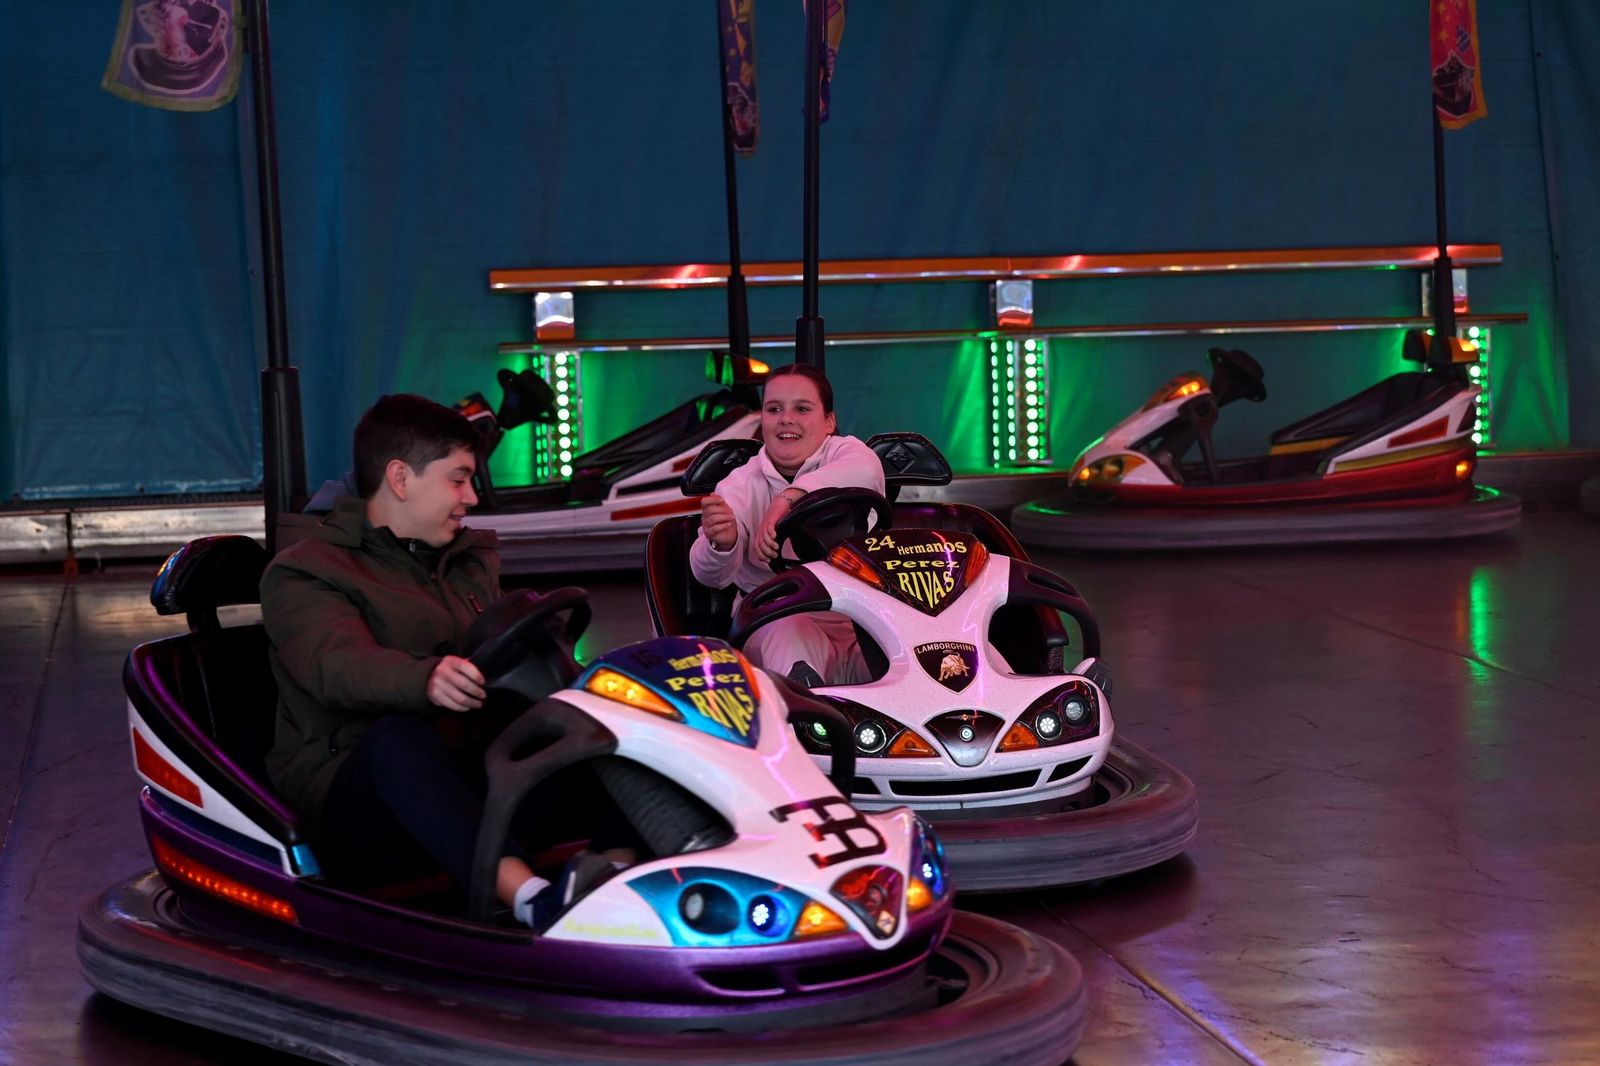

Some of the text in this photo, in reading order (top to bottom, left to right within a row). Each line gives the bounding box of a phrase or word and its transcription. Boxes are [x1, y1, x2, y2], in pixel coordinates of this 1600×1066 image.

[865, 535, 967, 555] 24 Hermanos
[883, 560, 960, 570] Perez
[897, 570, 955, 608] RIVAS
[916, 642, 975, 653] LAMBORGHINI
